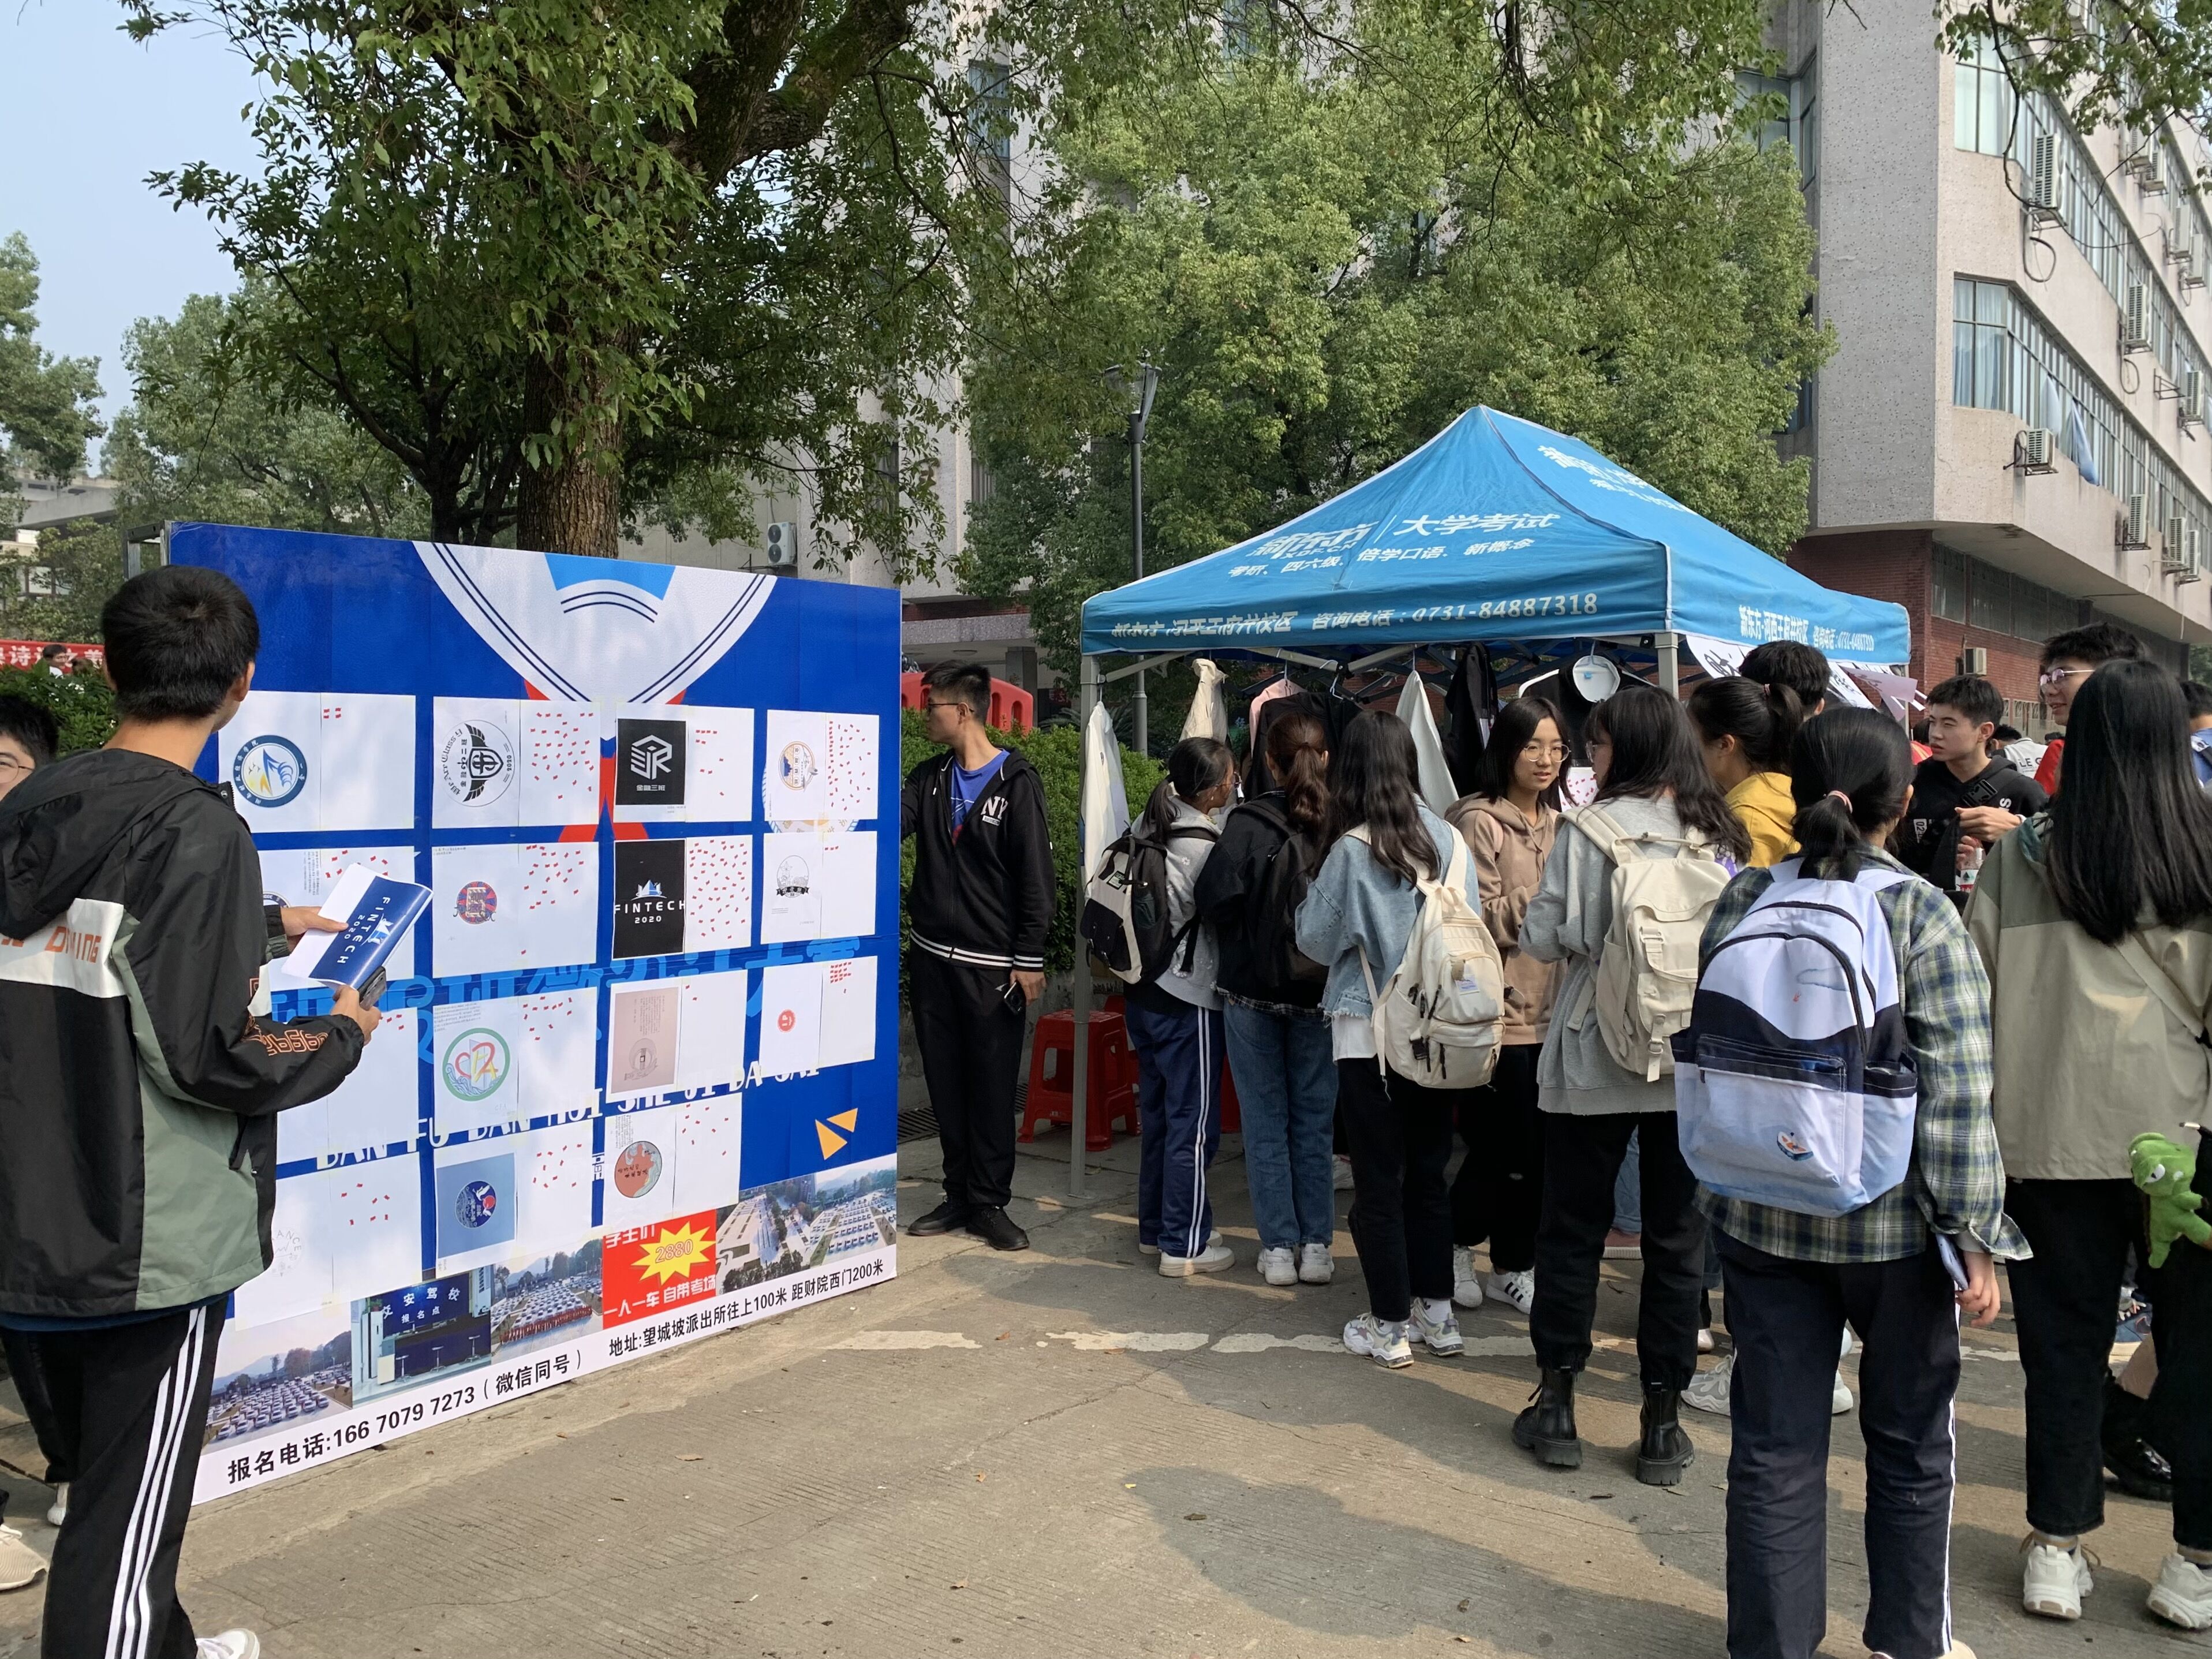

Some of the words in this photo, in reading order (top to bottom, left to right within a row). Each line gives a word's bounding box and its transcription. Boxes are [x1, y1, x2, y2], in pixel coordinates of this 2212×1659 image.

[1245, 521, 1380, 559] 新东方
[1393, 513, 1560, 536] 大学考试
[1463, 538, 1535, 556] 新概念
[980, 796, 1008, 820] NY
[614, 900, 686, 914] FINTECH
[337, 896, 391, 963] FINTECH
[344, 914, 365, 939] 2020
[634, 916, 662, 924] 2020
[656, 1239, 693, 1264] 2880
[791, 1258, 884, 1302] 距财院西门200米
[604, 1290, 660, 1317] 一人一车
[663, 1274, 716, 1304] 自带考场
[401, 1306, 440, 1324] 报名点
[376, 1403, 423, 1434] 7079
[430, 1386, 475, 1415] 7273
